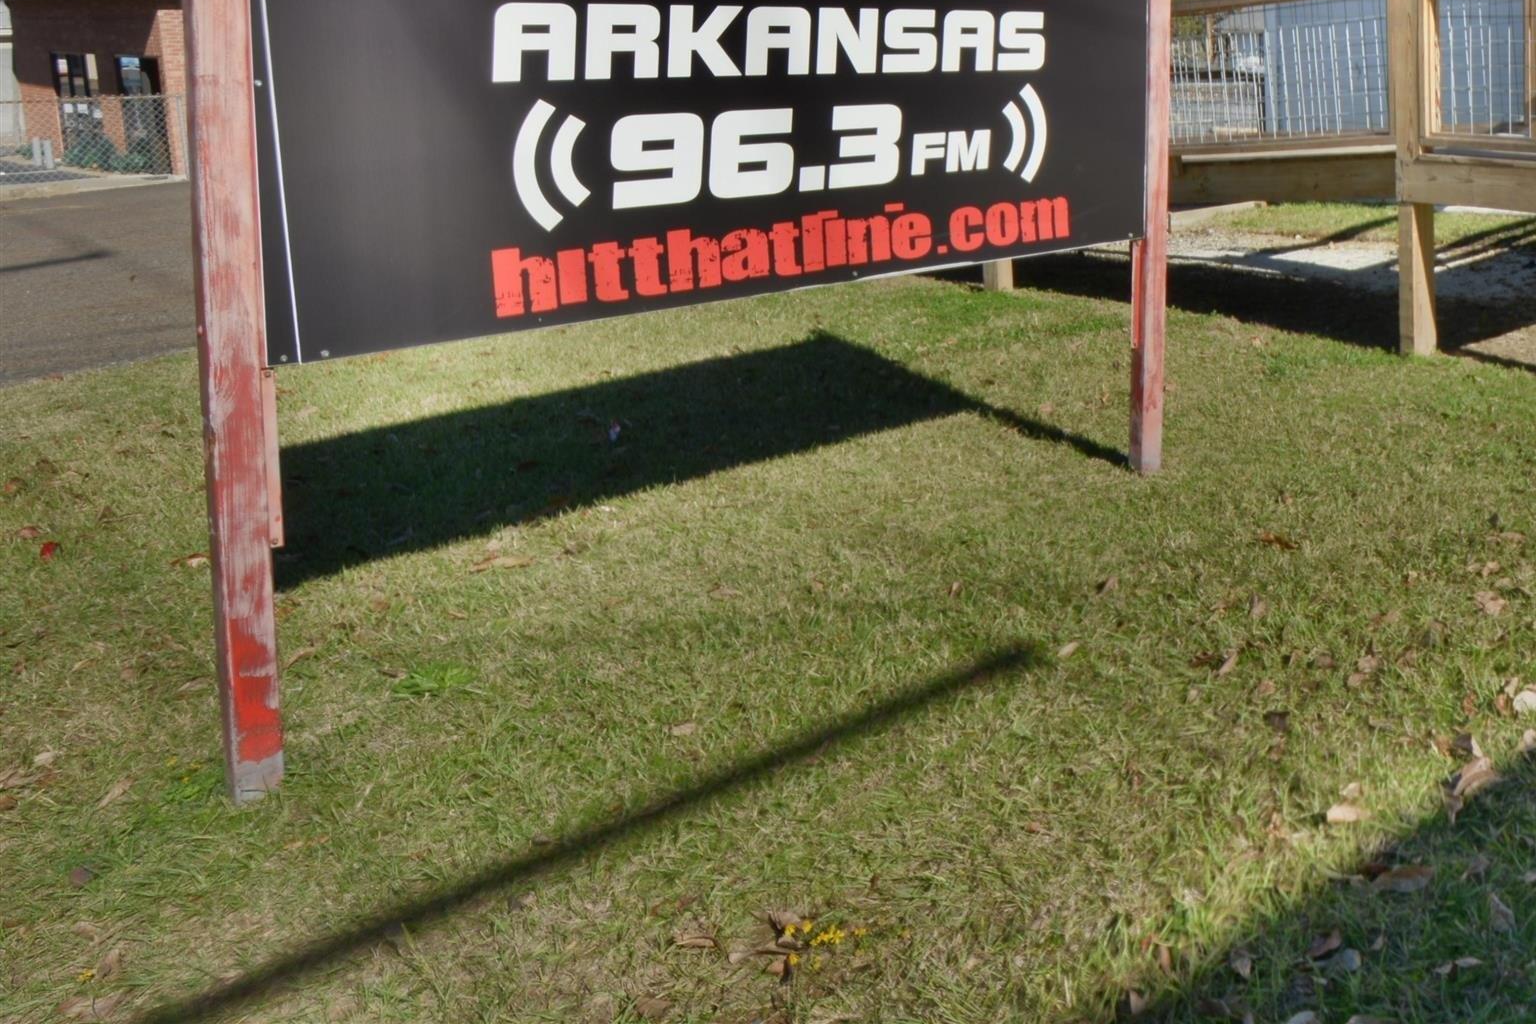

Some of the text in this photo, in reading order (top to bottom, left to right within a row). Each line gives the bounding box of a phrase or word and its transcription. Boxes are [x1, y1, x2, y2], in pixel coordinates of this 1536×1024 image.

[492, 2, 1046, 83] ARKANSAS
[609, 103, 992, 210] 96.3 FM
[491, 195, 1071, 318] hitthatline.com
